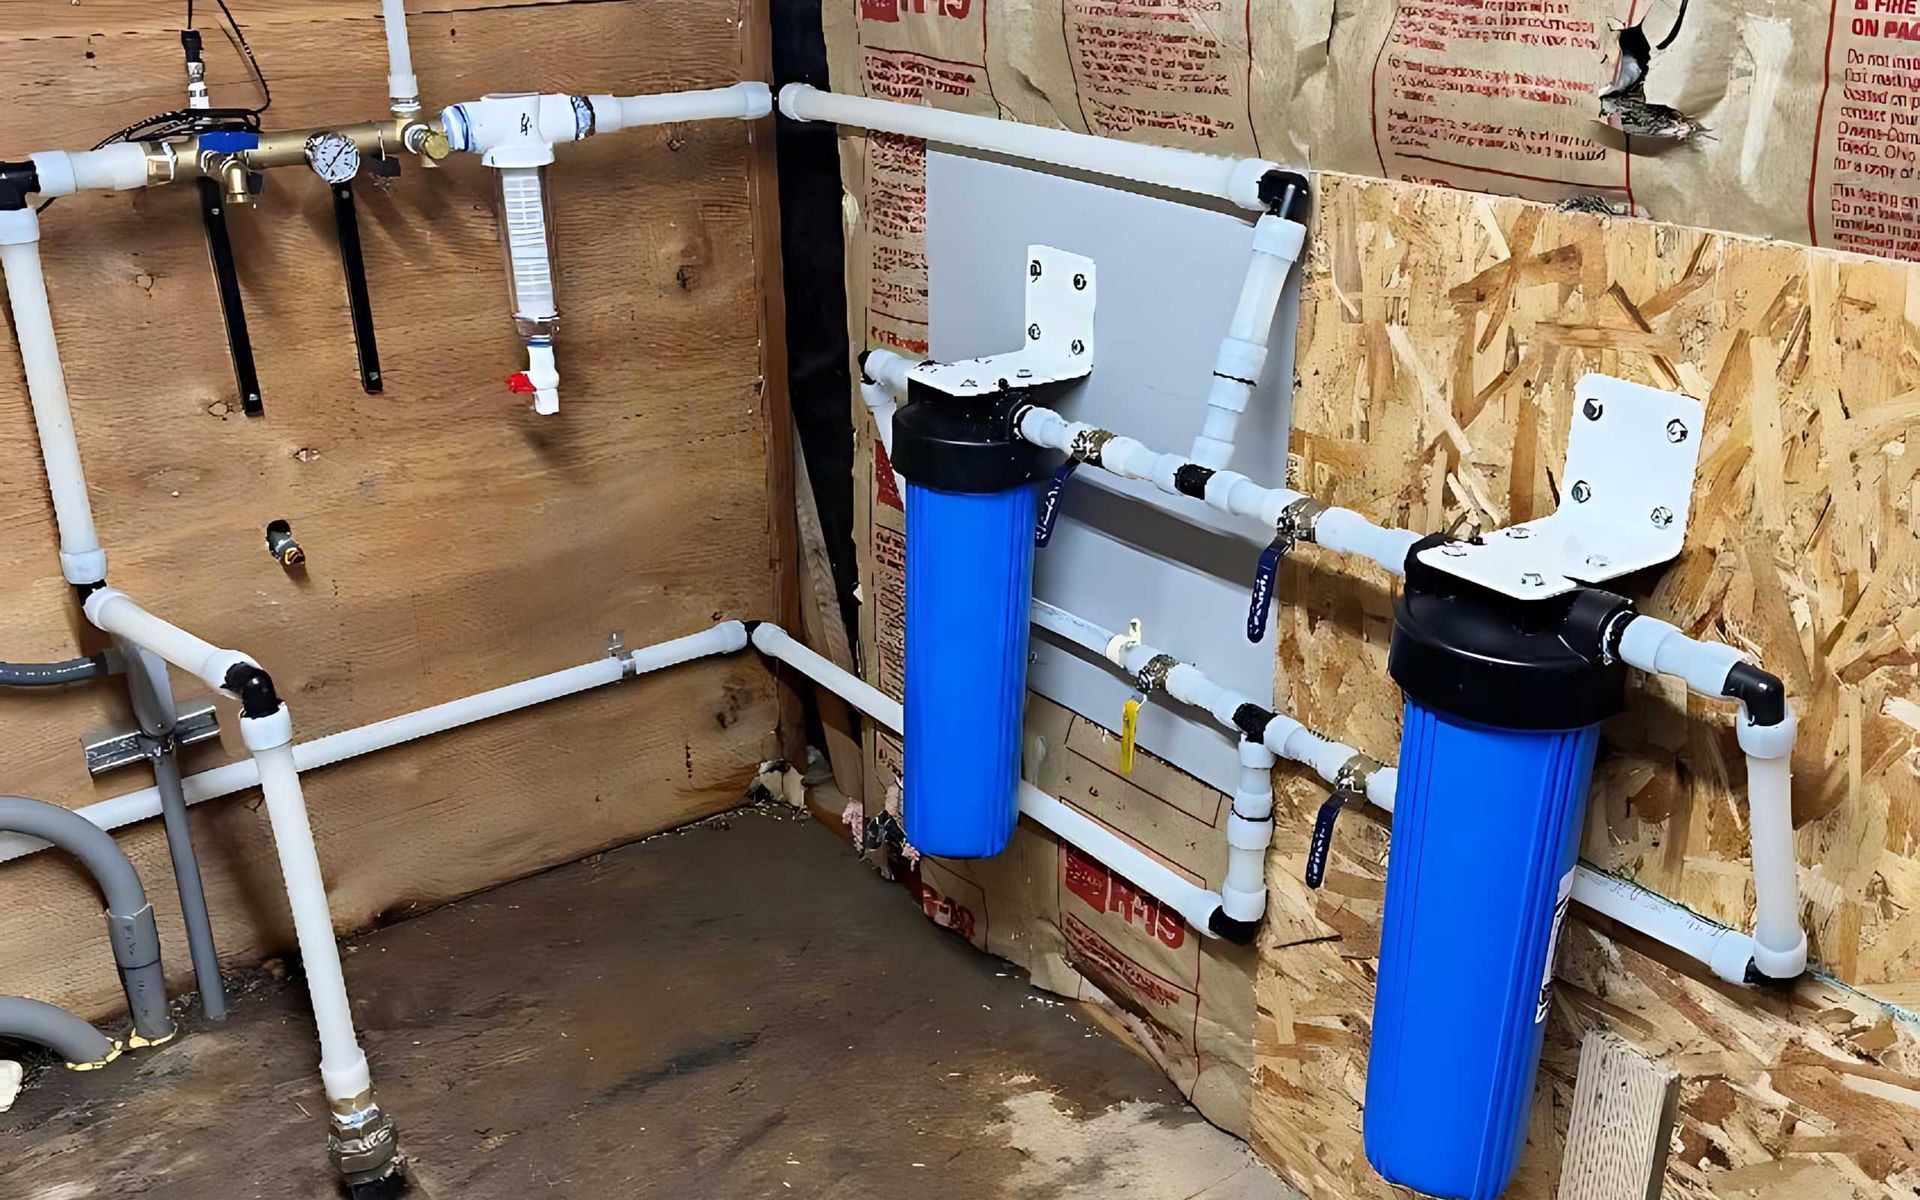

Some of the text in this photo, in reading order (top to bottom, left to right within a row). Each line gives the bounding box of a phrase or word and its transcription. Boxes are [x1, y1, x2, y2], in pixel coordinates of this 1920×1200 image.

[1852, 18, 1879, 37] ON
[1848, 48, 1864, 64] Do
[1868, 54, 1890, 68] not
